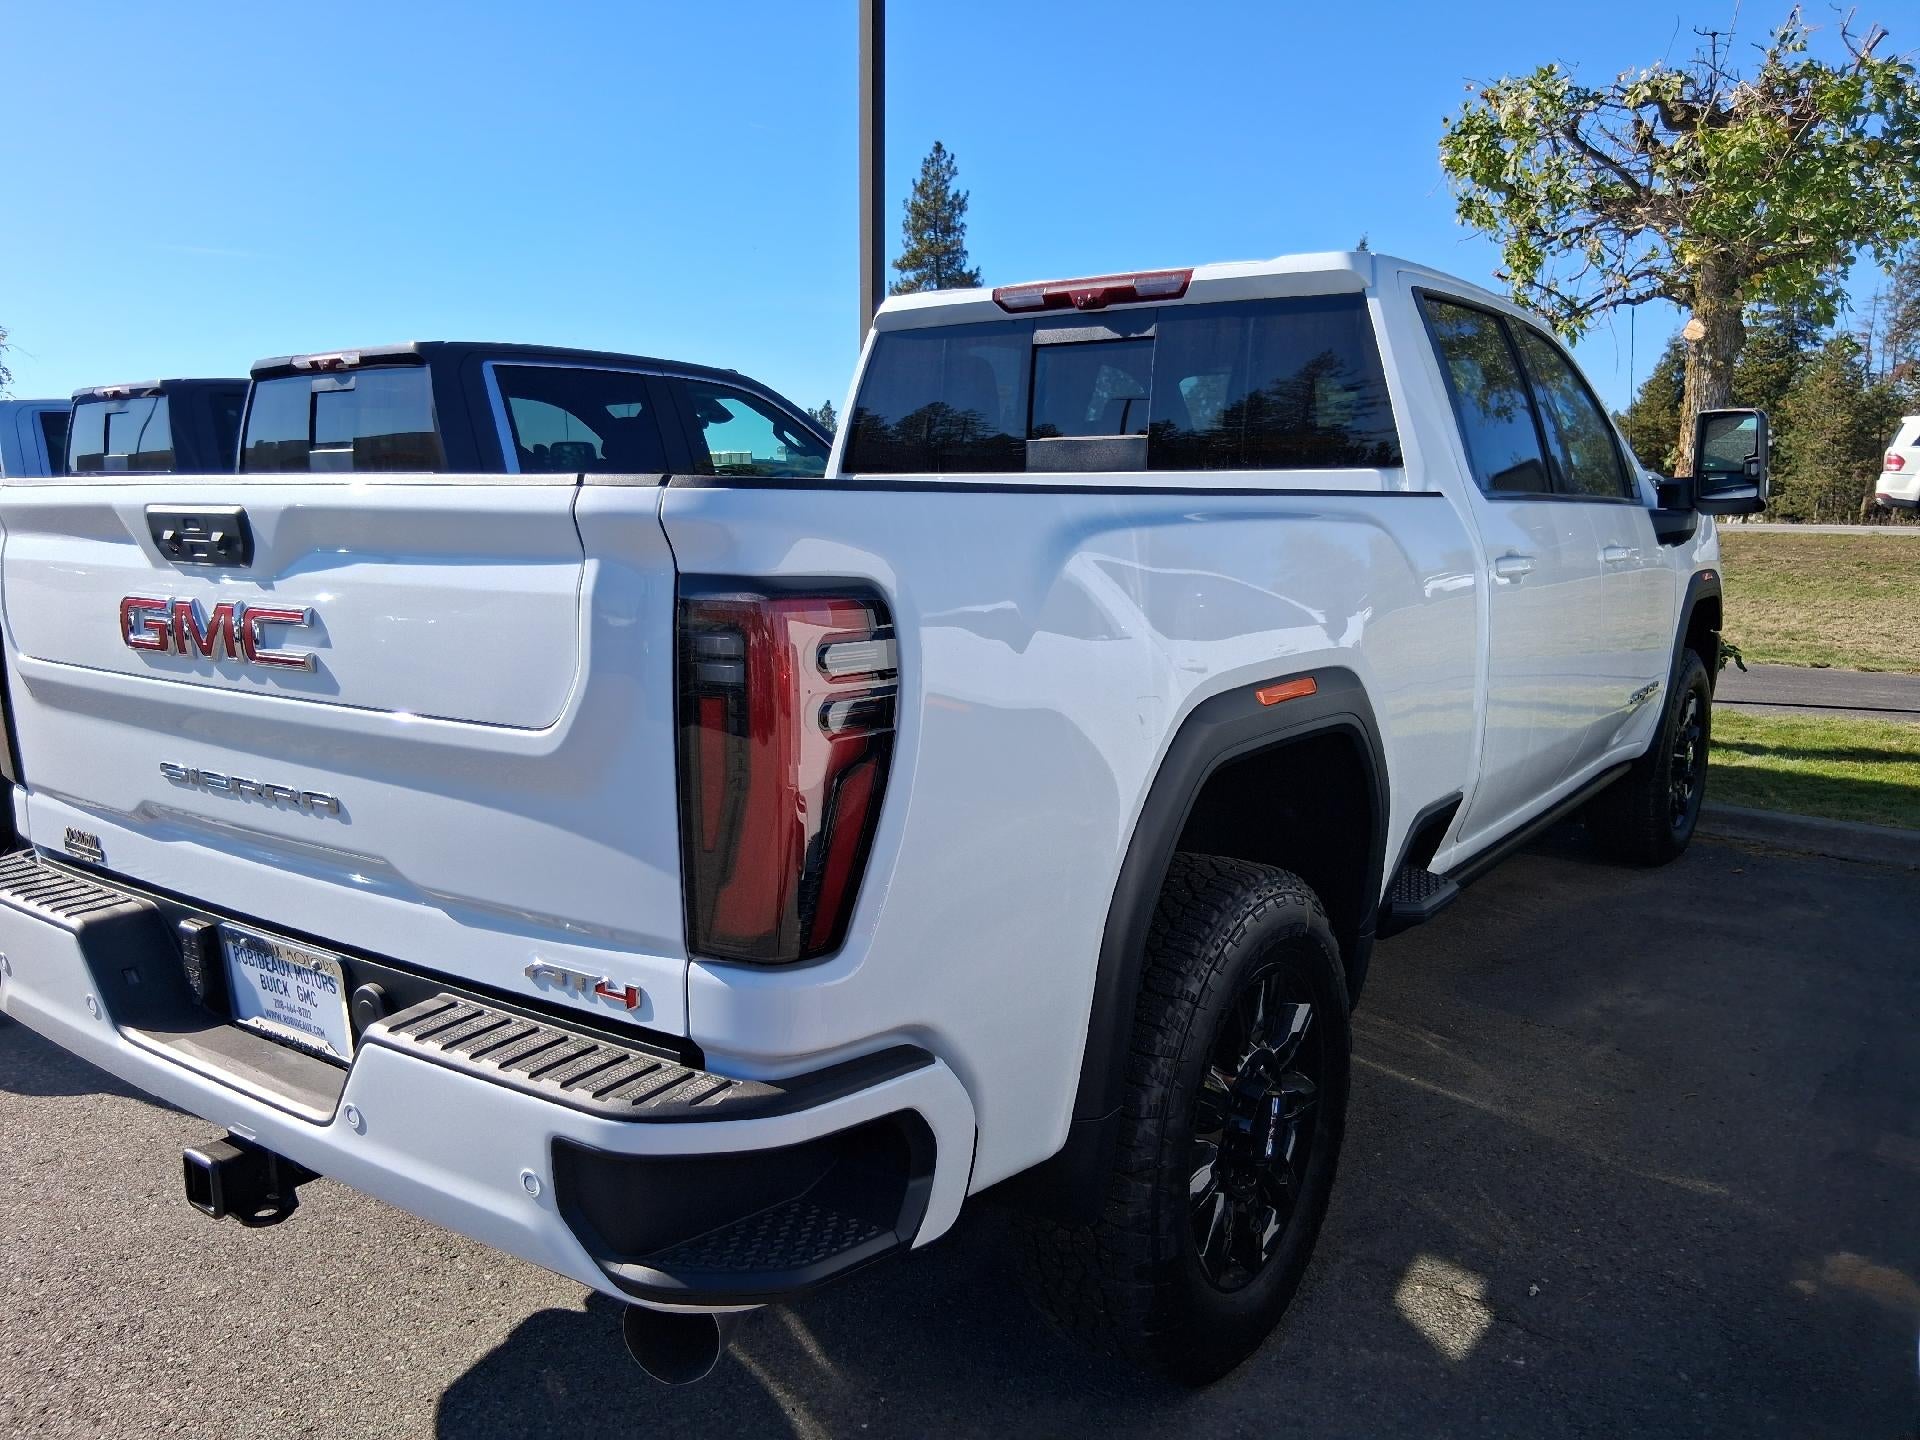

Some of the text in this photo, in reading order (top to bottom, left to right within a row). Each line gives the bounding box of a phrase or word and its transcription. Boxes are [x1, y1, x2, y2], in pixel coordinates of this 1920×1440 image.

[119, 592, 318, 674] GMC
[160, 761, 341, 815] SIERRA
[233, 945, 337, 995] ROBIDEAUX MOTORS
[260, 974, 319, 1009] BUICK GMC
[524, 957, 642, 1013] AT4
